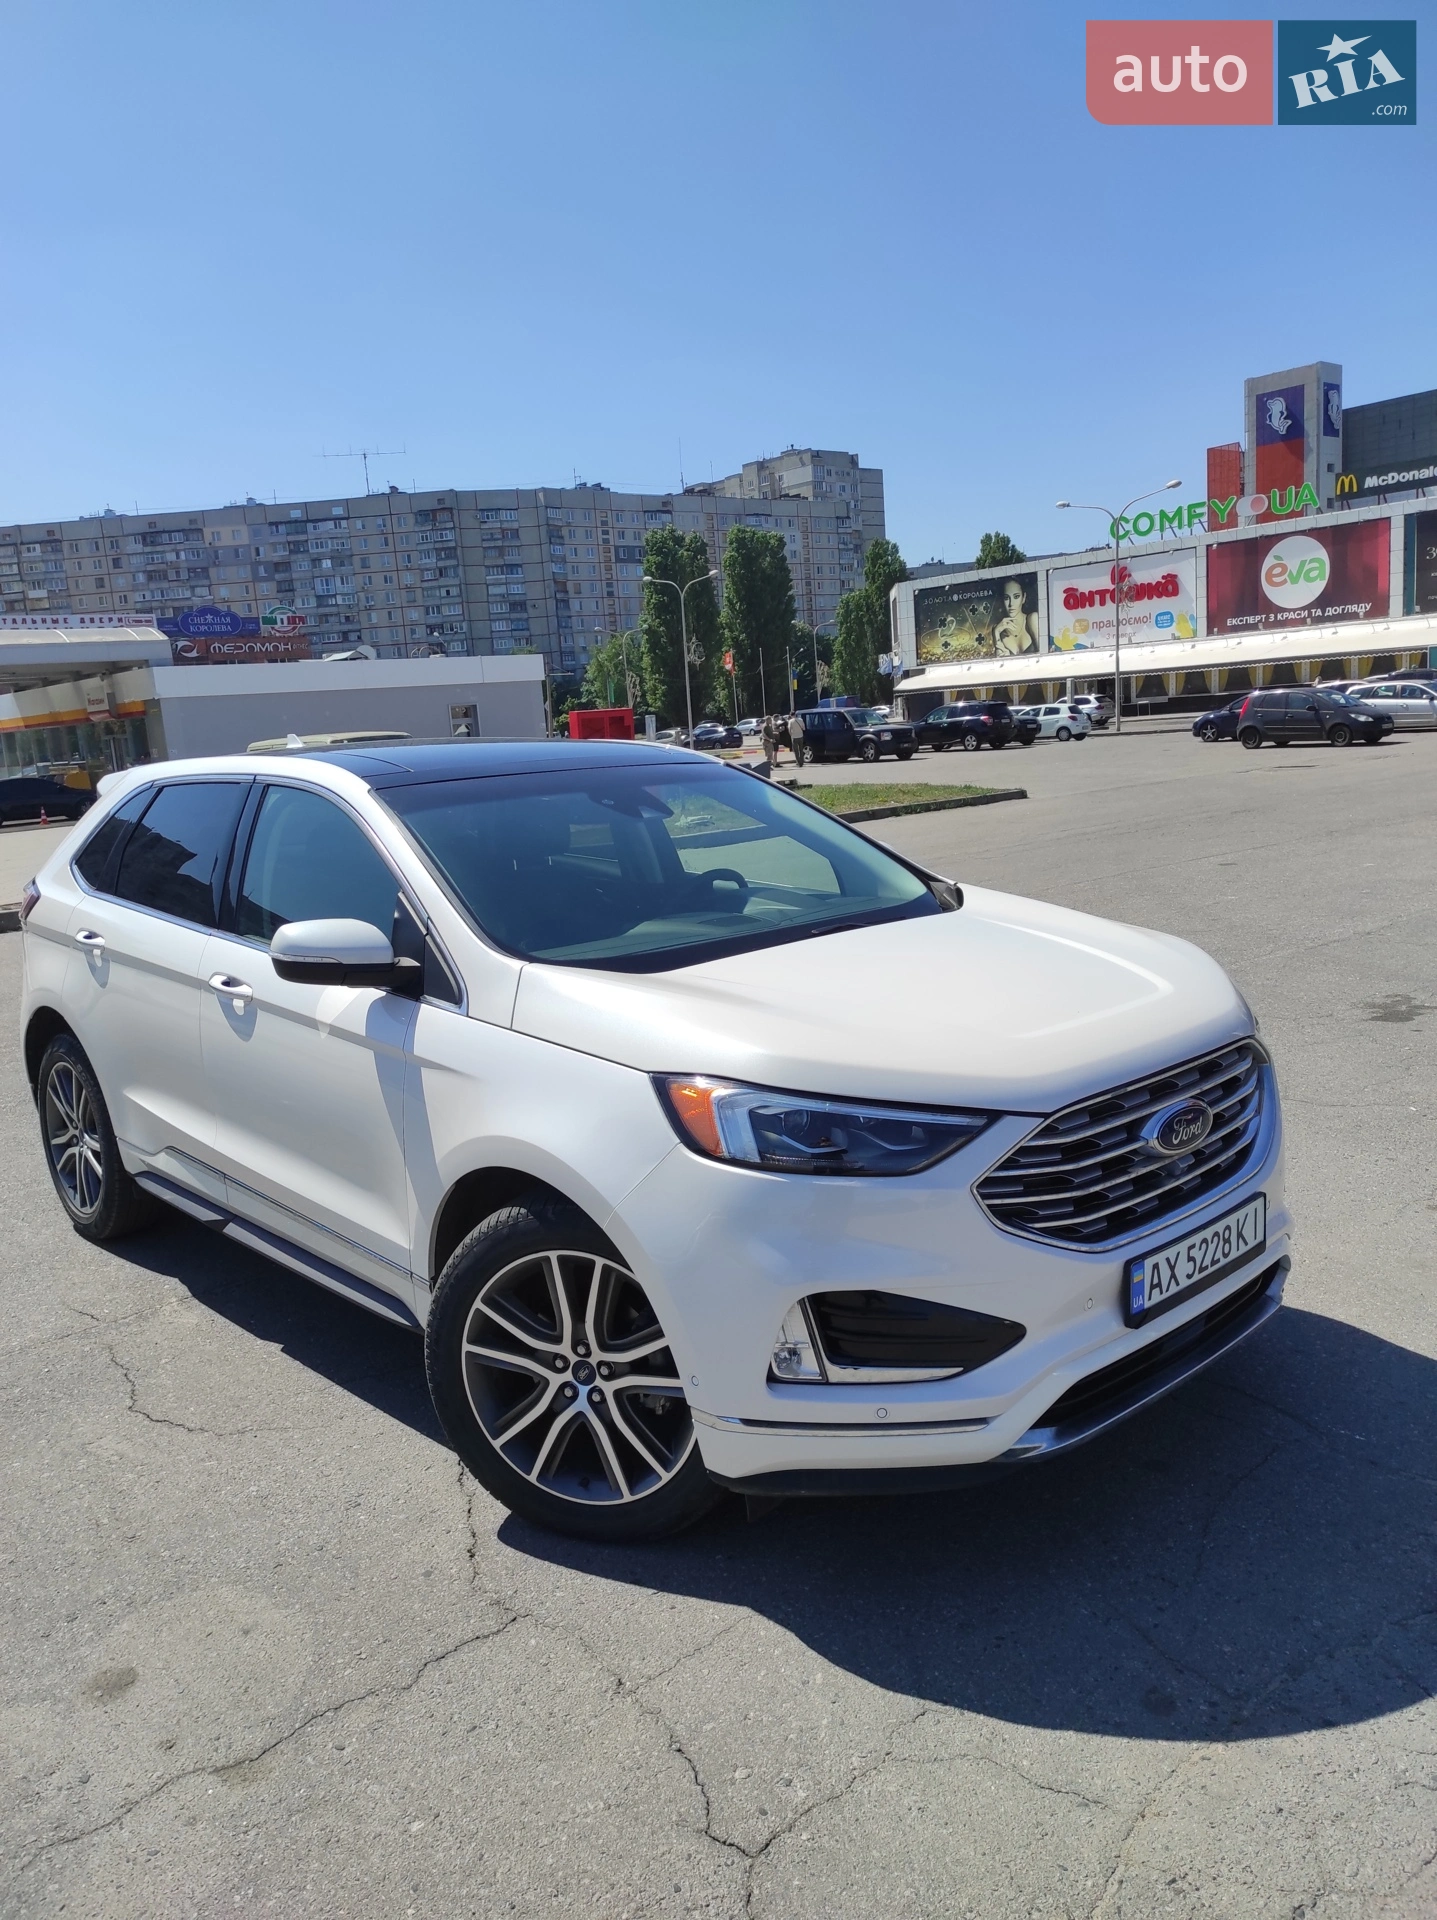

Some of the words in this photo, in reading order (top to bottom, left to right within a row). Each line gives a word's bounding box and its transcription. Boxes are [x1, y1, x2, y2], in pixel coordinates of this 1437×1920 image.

[1110, 496, 1237, 541] COMFY
[79, 616, 124, 624] ДВЕРИ
[188, 614, 231, 624] СНЕЖНАЯ
[1226, 614, 1266, 627] ЕКСПЕРТ
[1277, 609, 1309, 621] КРАСИ
[1311, 608, 1323, 618] ТА
[1324, 602, 1372, 616] ДОГЛЯДУ
[190, 625, 232, 633] КОРОЛЕВА
[1172, 1111, 1204, 1145] Ford
[1133, 1296, 1144, 1308] UA
